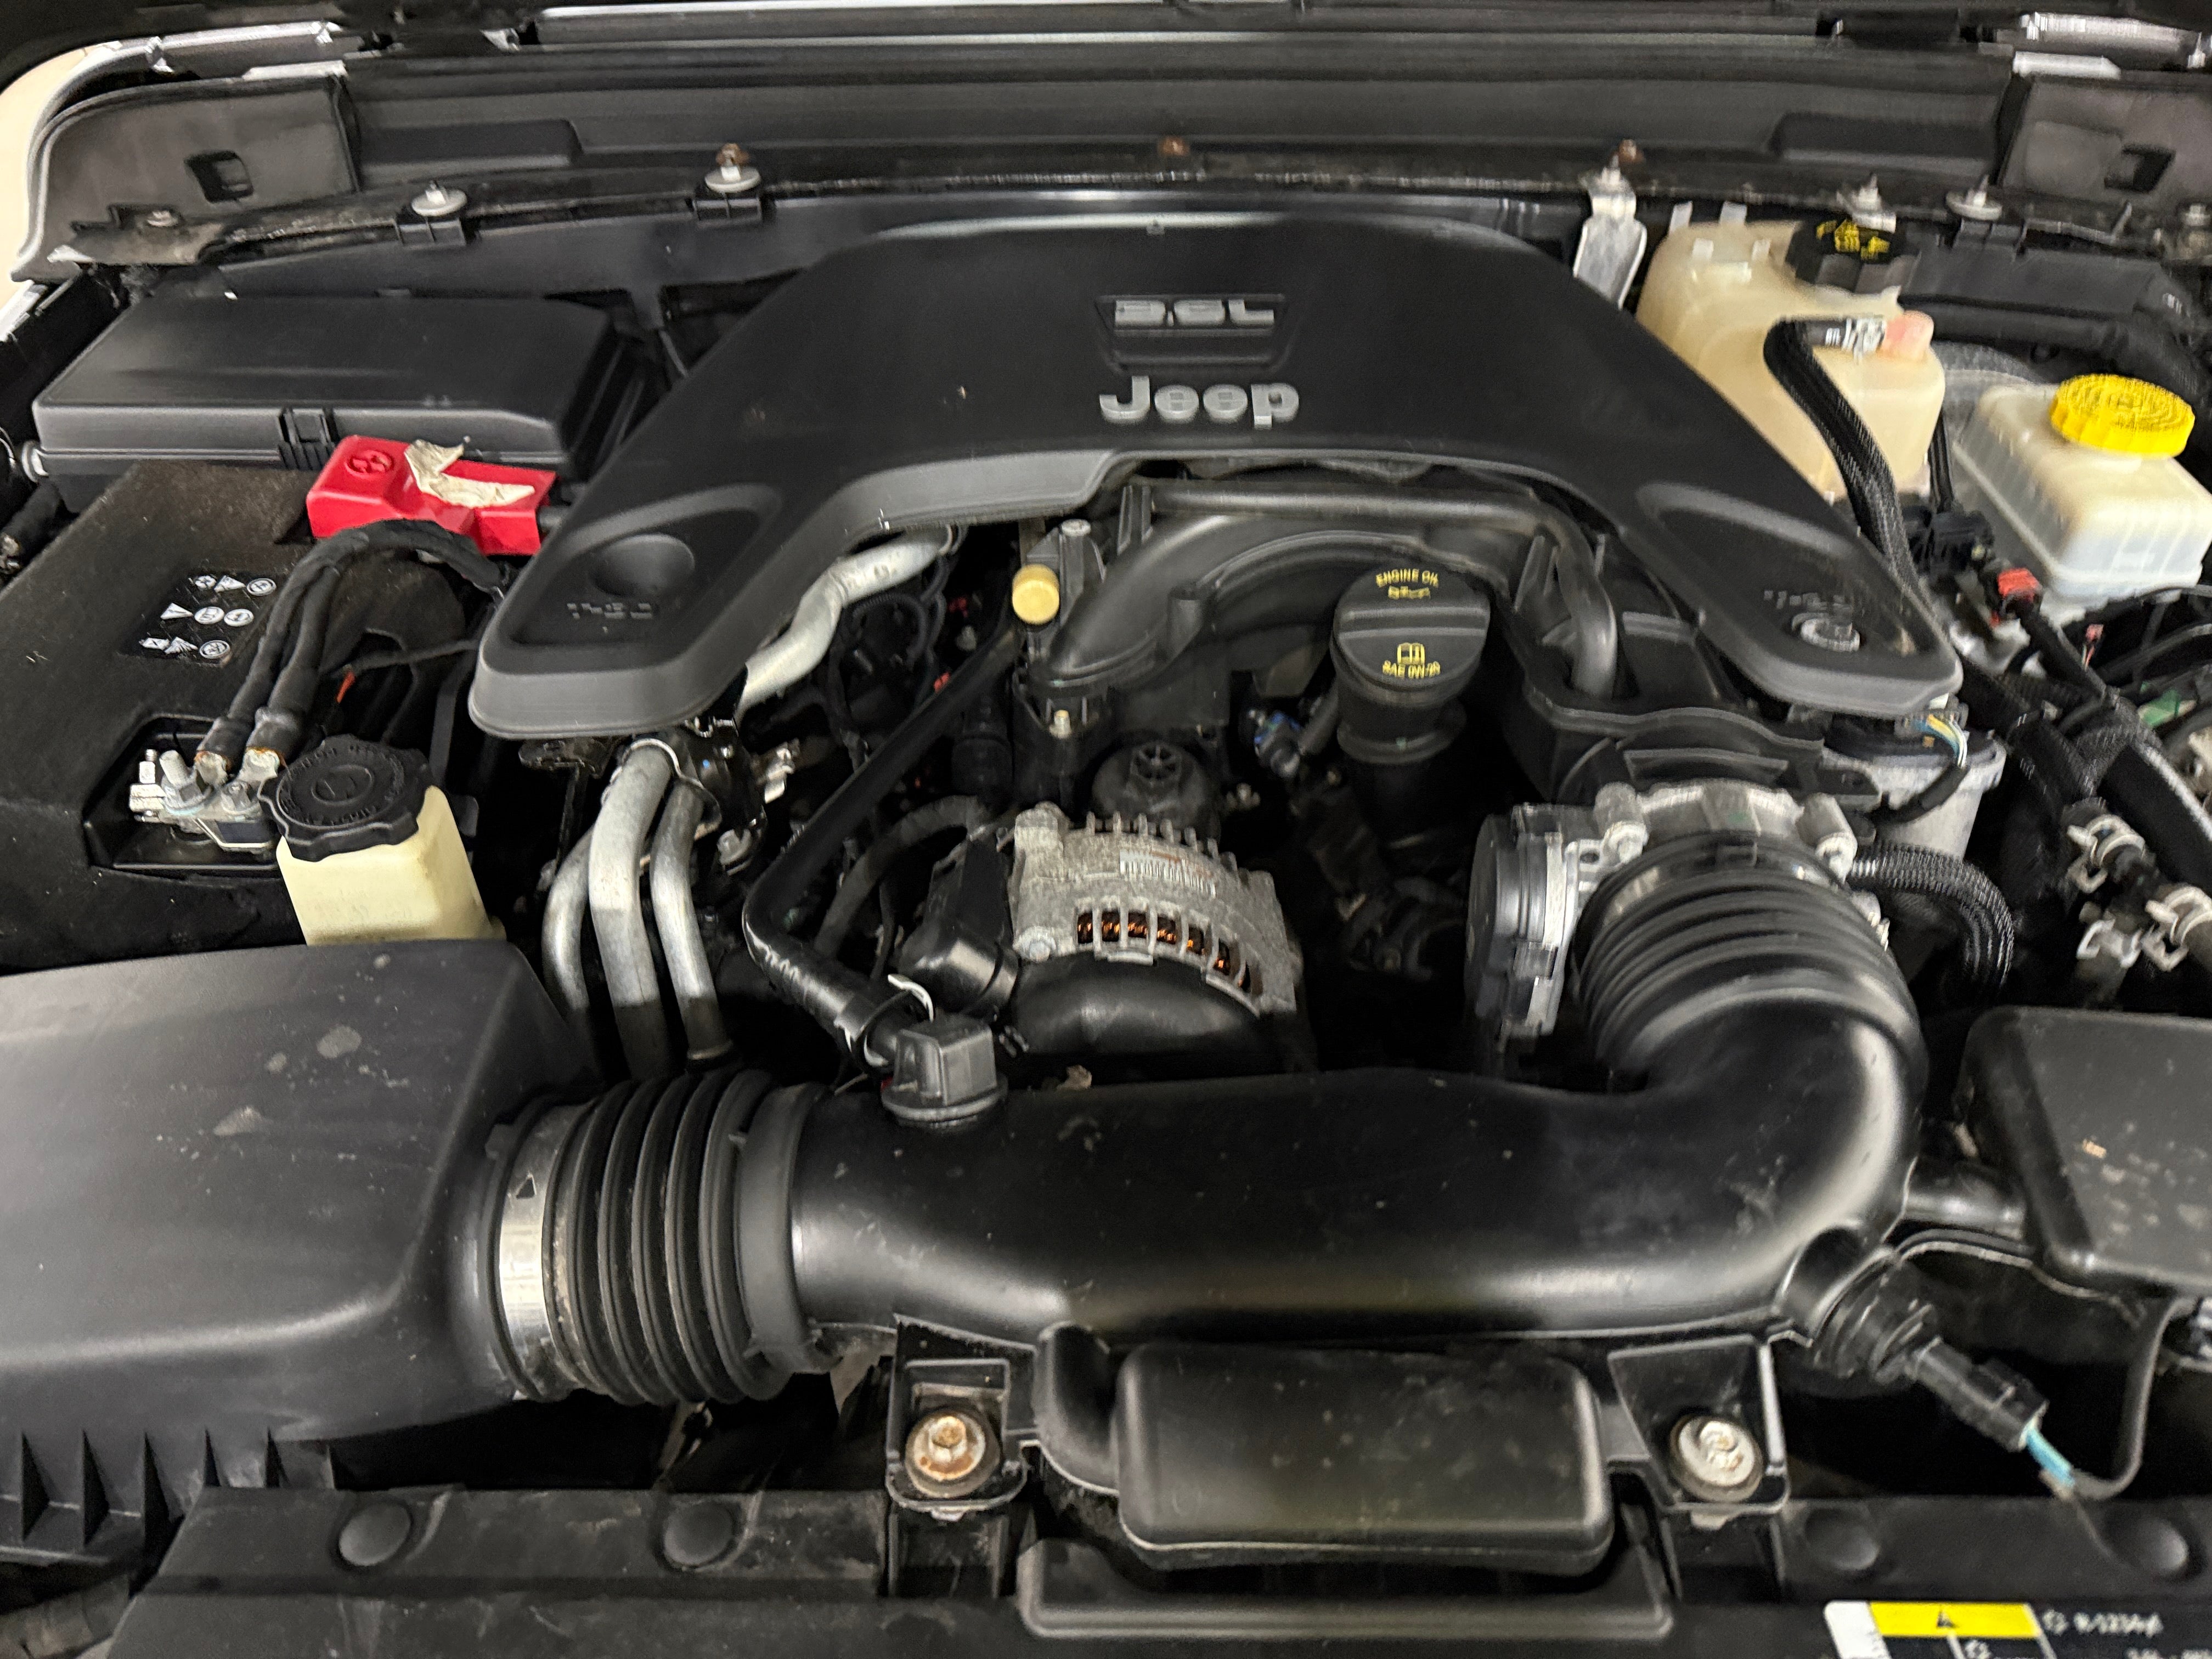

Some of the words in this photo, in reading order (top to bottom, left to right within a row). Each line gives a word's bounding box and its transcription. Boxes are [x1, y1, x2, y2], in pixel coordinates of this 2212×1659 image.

[1099, 375, 1300, 430] Jeep
[1375, 568, 1420, 588] ENGINE
[1421, 570, 1440, 588] OIL
